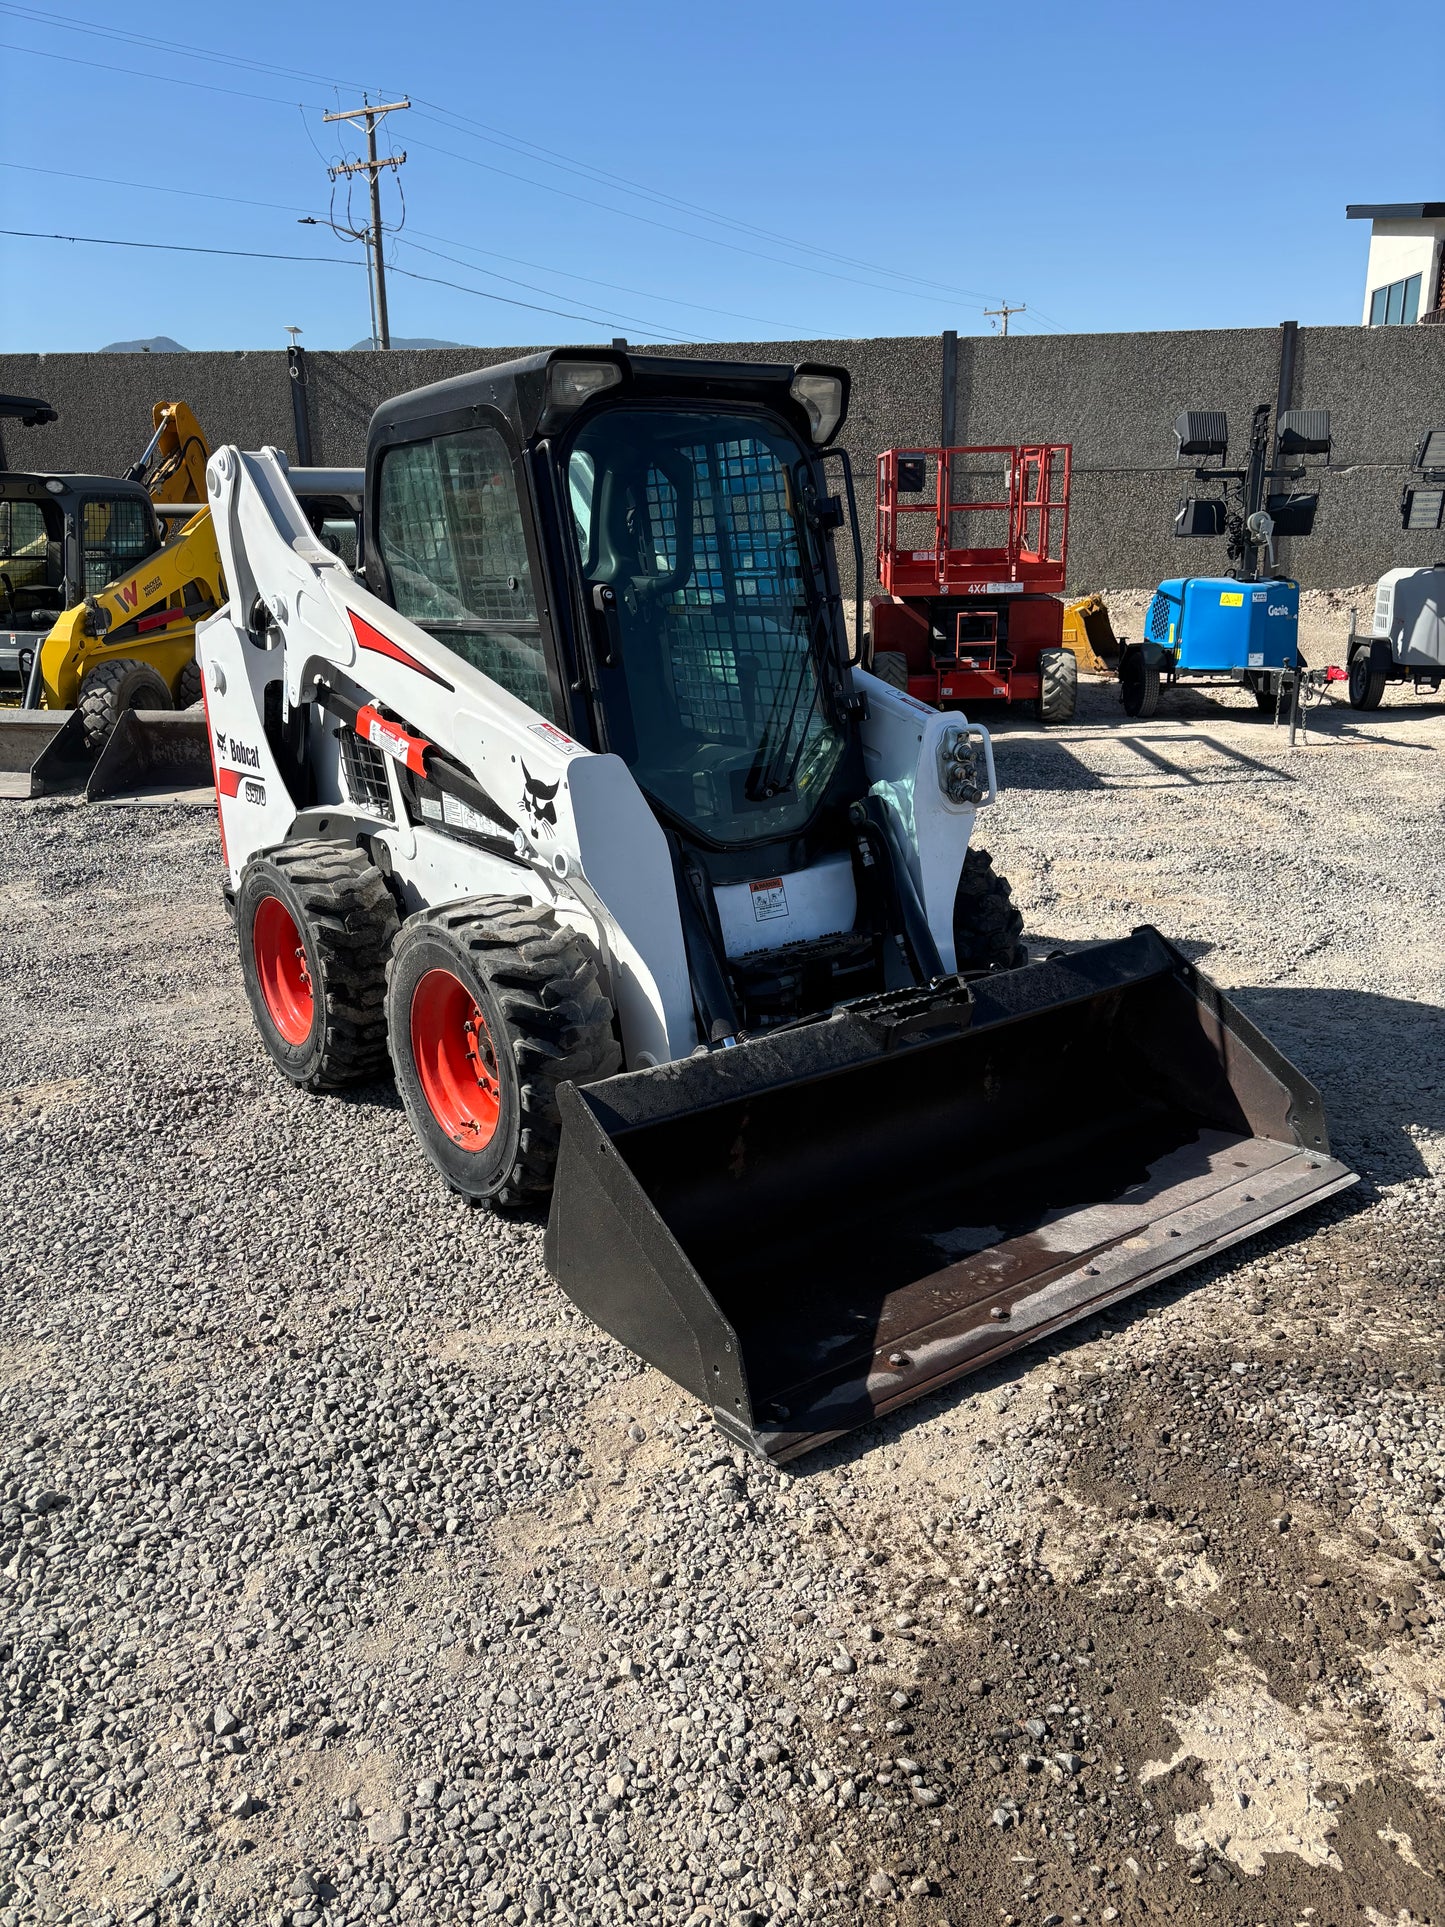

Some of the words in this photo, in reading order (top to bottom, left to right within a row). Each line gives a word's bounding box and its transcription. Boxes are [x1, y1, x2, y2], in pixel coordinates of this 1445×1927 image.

[142, 575, 160, 591] WACKER
[145, 579, 163, 598] NEUSON
[967, 583, 987, 594] 4X4
[1268, 604, 1289, 617] Genie
[229, 738, 260, 769] Bobcat
[245, 781, 267, 807] S570
